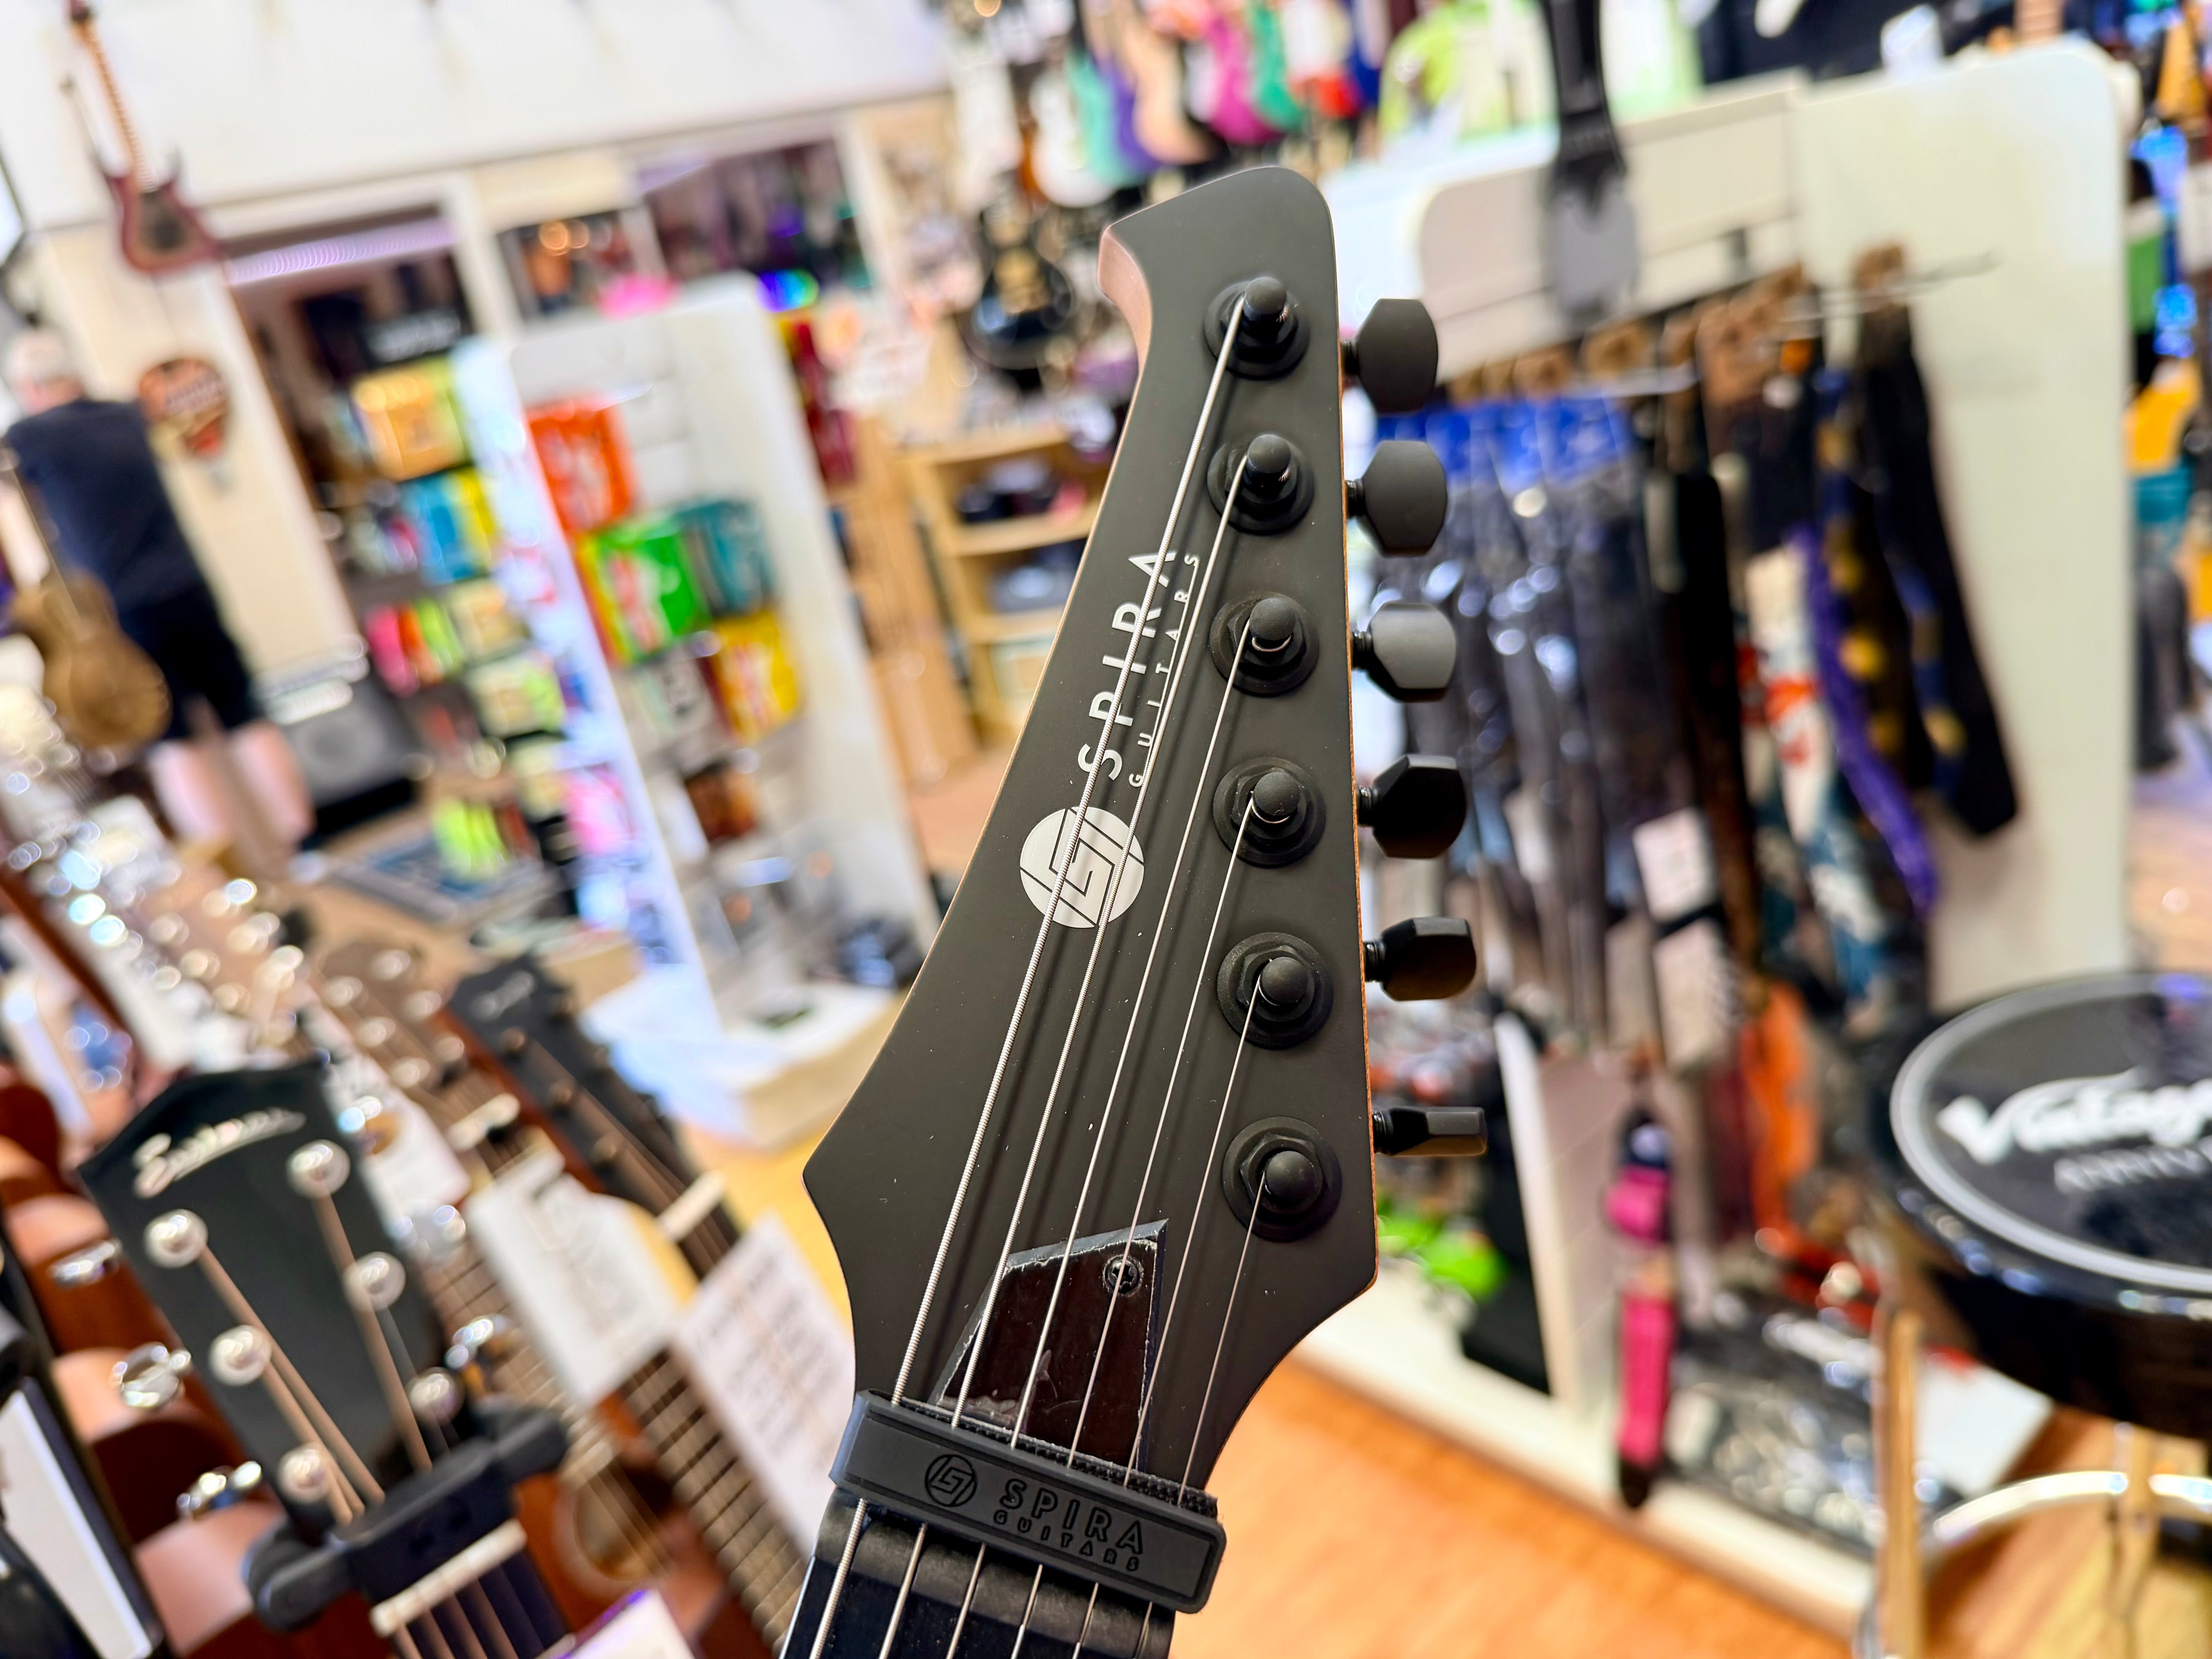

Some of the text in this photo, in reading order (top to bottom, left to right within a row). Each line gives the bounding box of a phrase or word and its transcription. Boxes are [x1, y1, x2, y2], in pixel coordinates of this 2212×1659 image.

[1078, 551, 1176, 780] SPIRA
[1129, 555, 1199, 787] GUITARS
[994, 1510, 1139, 1571] GUITARS
[1000, 1479, 1142, 1554] SPIRA
